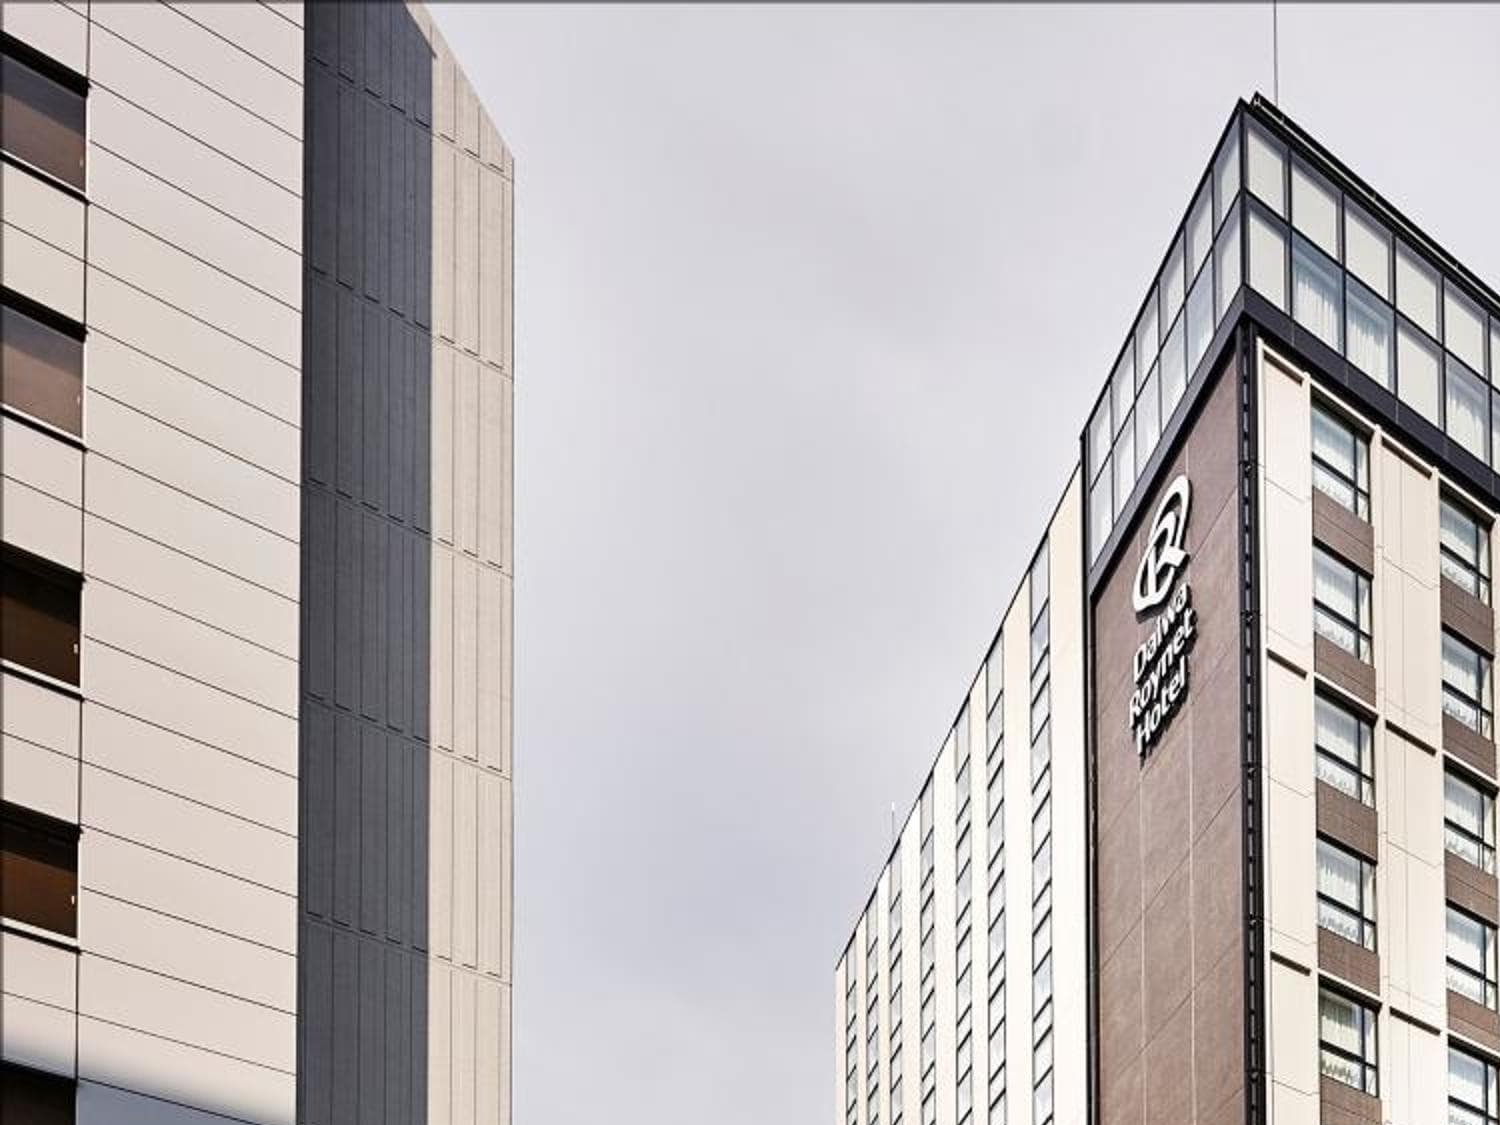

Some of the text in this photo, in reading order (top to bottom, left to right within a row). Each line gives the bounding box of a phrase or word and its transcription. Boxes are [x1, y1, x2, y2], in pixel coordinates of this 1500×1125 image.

[1129, 607, 1193, 729] Roynet
[1134, 582, 1188, 684] Daiwa
[1137, 655, 1186, 755] Hotel
